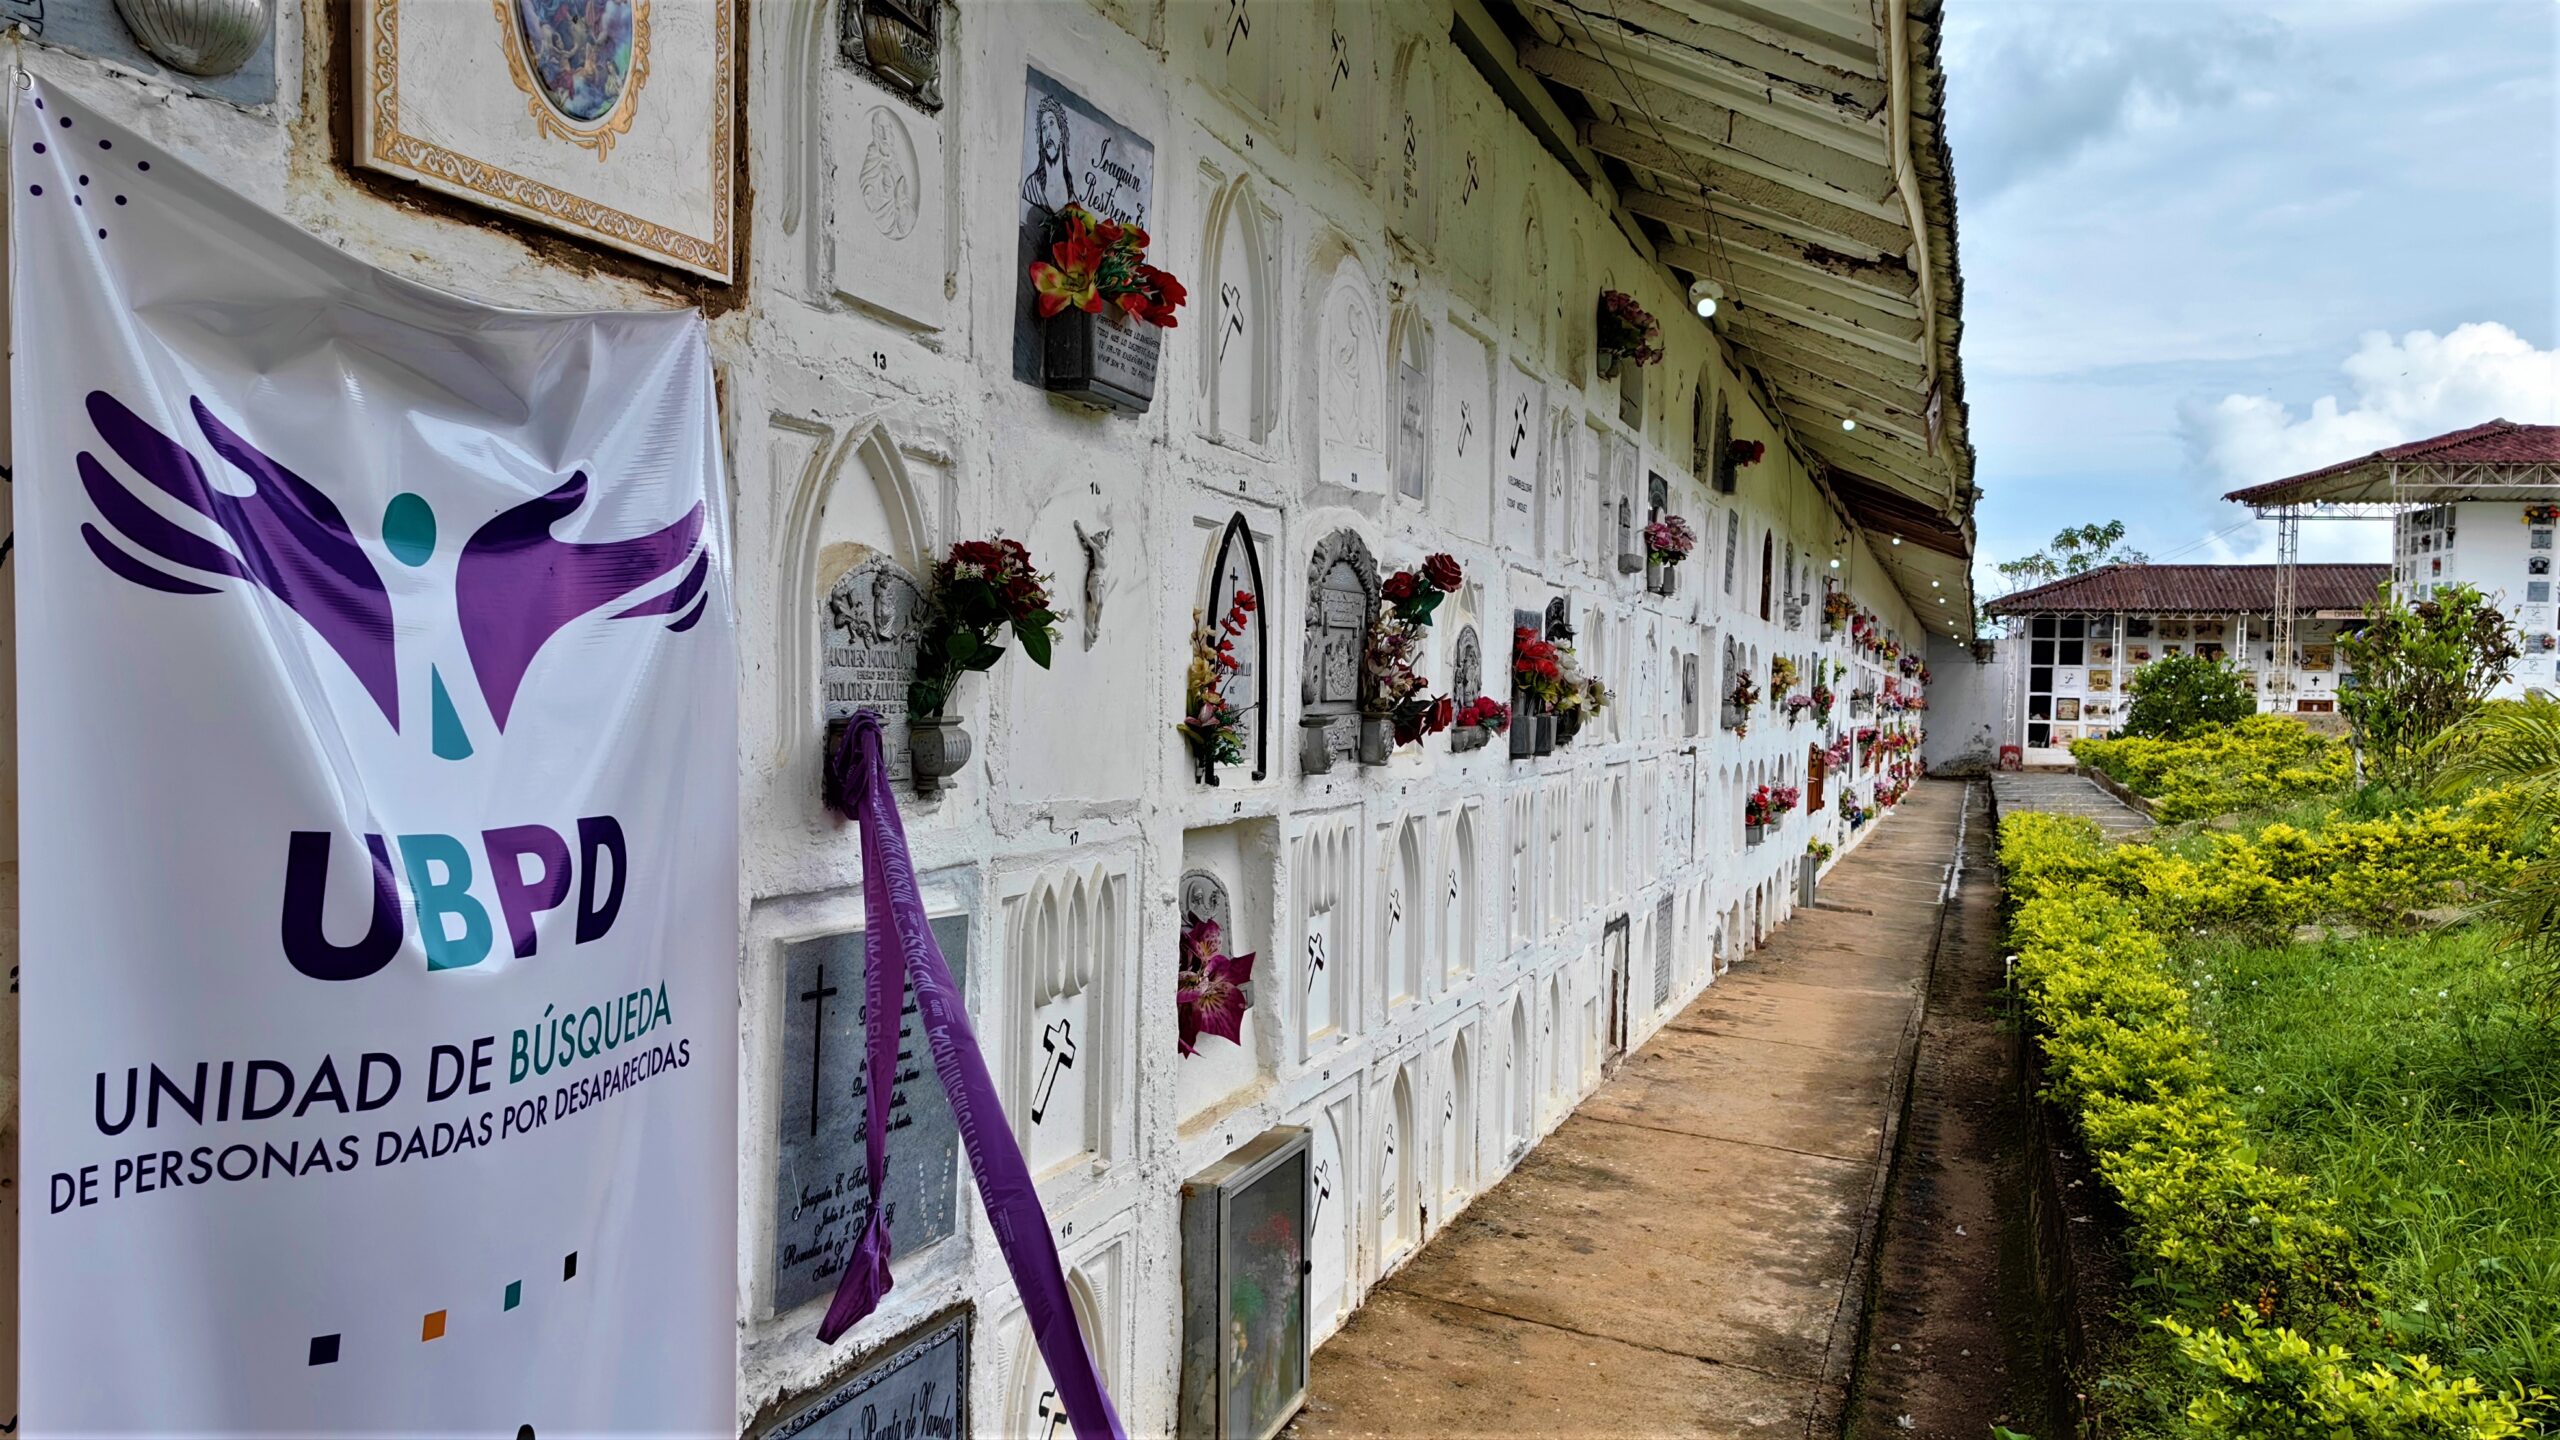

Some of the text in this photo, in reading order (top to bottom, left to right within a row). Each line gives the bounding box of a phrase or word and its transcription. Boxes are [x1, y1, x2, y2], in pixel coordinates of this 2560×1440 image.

[872, 351, 887, 371] 13
[1070, 830, 1079, 846] 17
[281, 815, 628, 981] UBPD
[95, 980, 673, 1137] UNIDAD DE BÚSQUEDA
[50, 1039, 691, 1215] DE PERSONAS DADAS POR DESAPARECIDAS
[1061, 1222, 1073, 1239] 16
[904, 1392, 916, 1437] de
